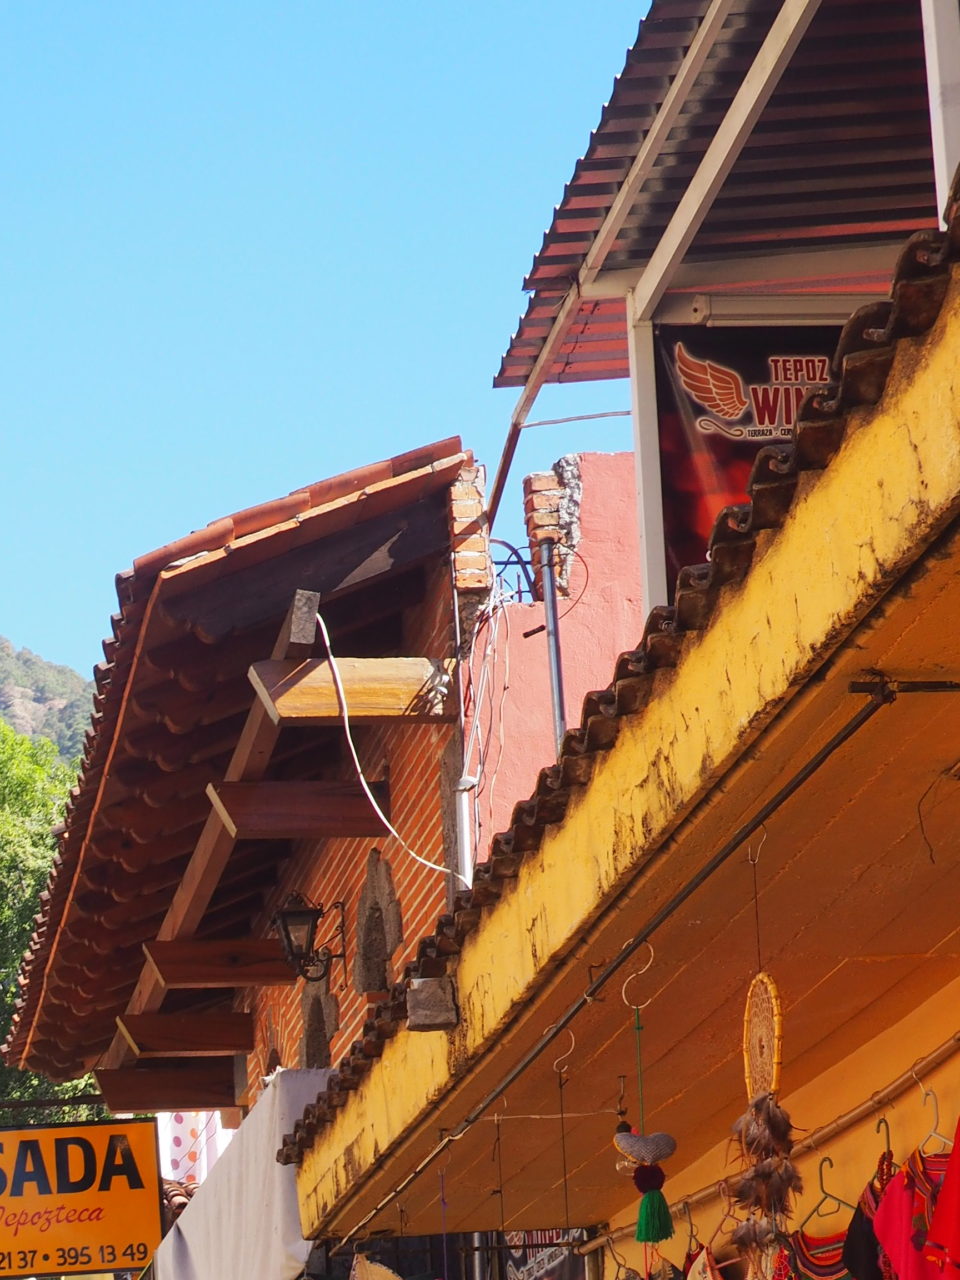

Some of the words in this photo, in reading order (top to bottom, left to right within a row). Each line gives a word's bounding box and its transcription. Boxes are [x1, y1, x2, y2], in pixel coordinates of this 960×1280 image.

[770, 358, 829, 382] TEPOZ
[17, 1250, 38, 1269] 37
[56, 1247, 93, 1267] 395
[99, 1244, 117, 1264] 13
[122, 1242, 149, 1262] 49
